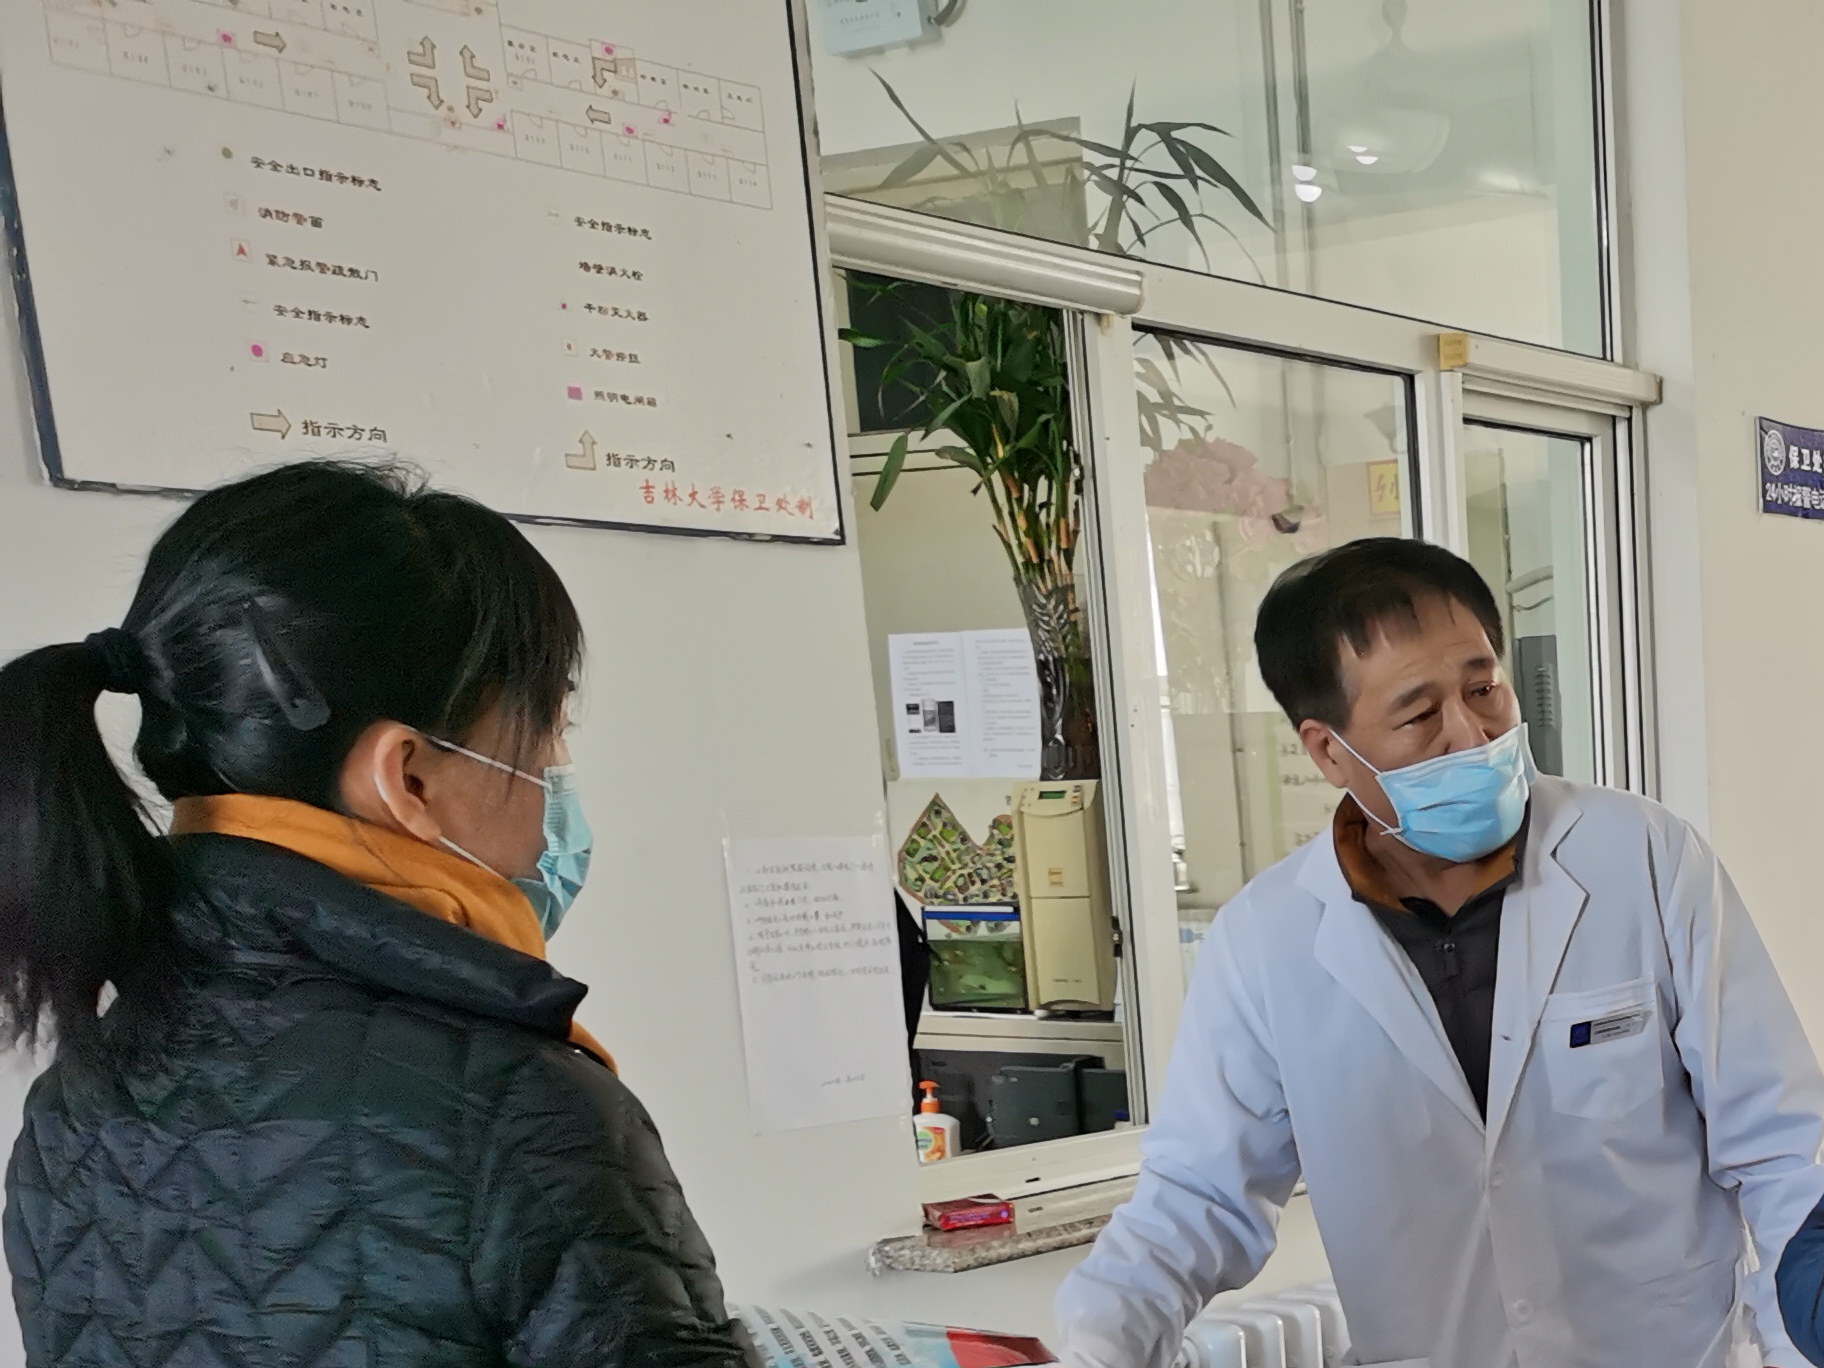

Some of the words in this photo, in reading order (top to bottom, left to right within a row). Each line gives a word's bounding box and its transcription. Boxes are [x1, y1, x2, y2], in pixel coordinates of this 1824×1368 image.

[272, 303, 371, 329] 安全指示标志
[300, 418, 388, 444] 指示方向
[605, 452, 677, 473] 指示方向
[638, 478, 815, 520] 吉林大学保卫处制
